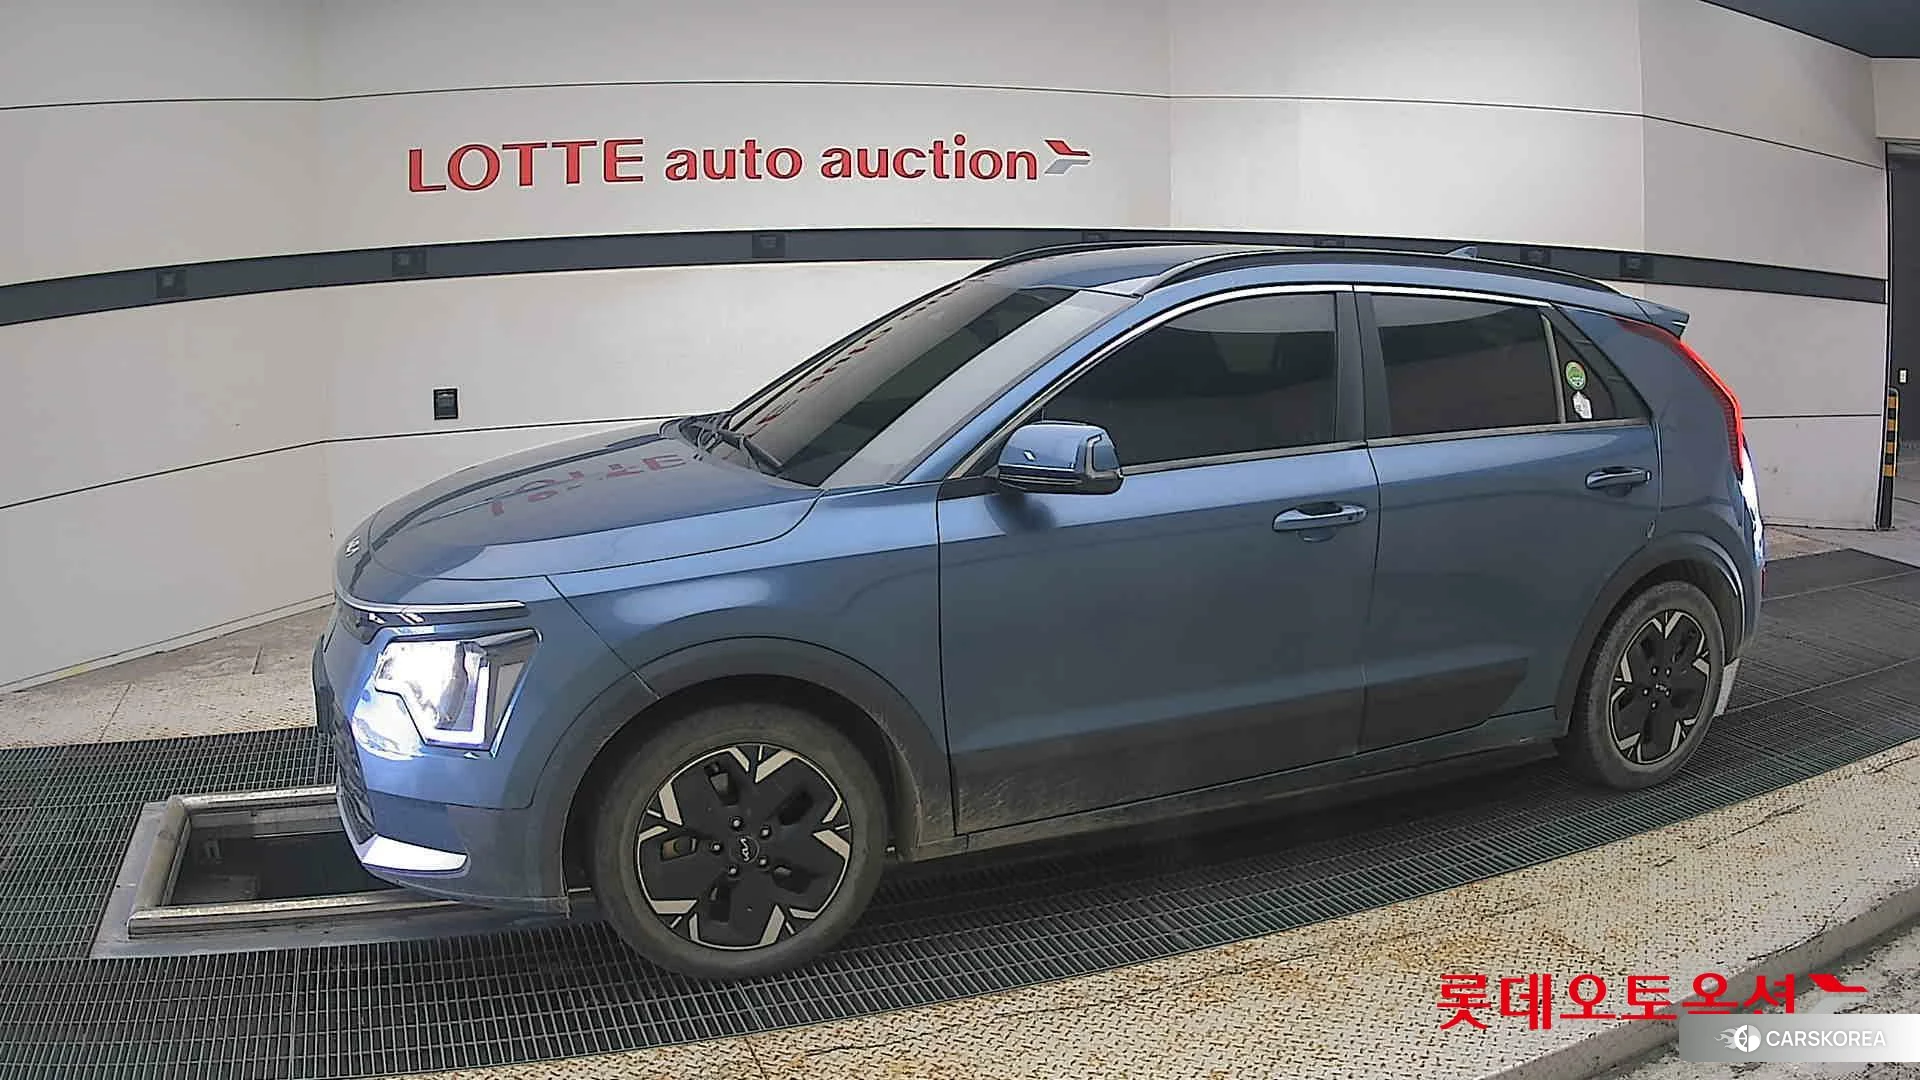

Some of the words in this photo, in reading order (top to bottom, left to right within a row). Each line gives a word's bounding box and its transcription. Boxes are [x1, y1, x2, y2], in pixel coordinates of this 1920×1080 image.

[409, 138, 643, 193] LOTTE
[664, 139, 804, 181] auto
[820, 134, 1039, 181] auction
